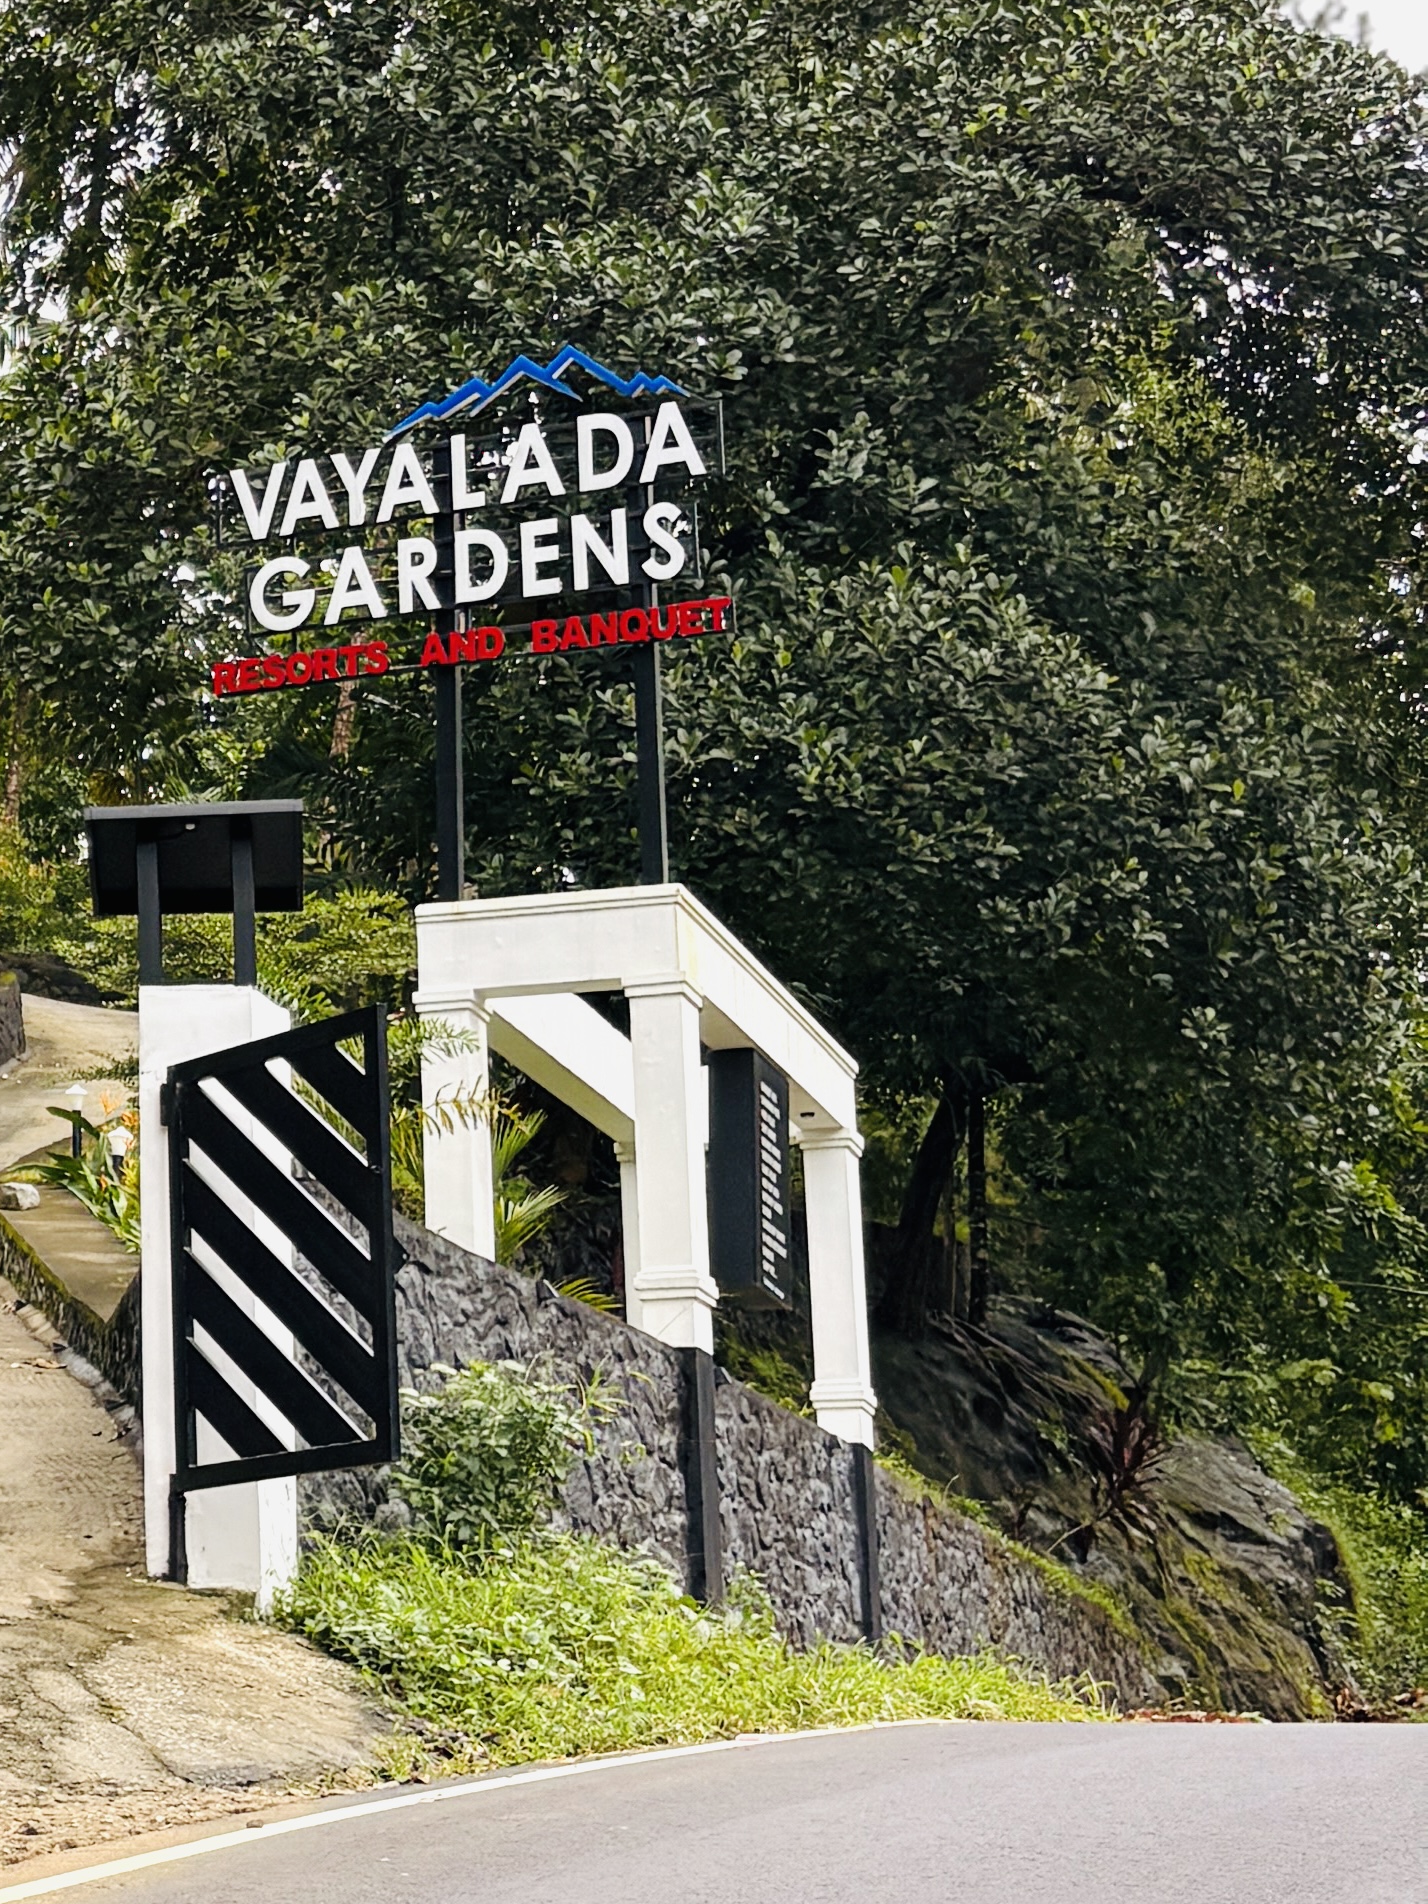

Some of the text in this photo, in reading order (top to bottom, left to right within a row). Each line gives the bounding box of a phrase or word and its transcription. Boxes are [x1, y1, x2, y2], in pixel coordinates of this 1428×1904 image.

[230, 401, 707, 540] VAYALADA
[250, 502, 687, 632] GARDENS
[212, 597, 732, 696] RESORTS AND BANQUET
